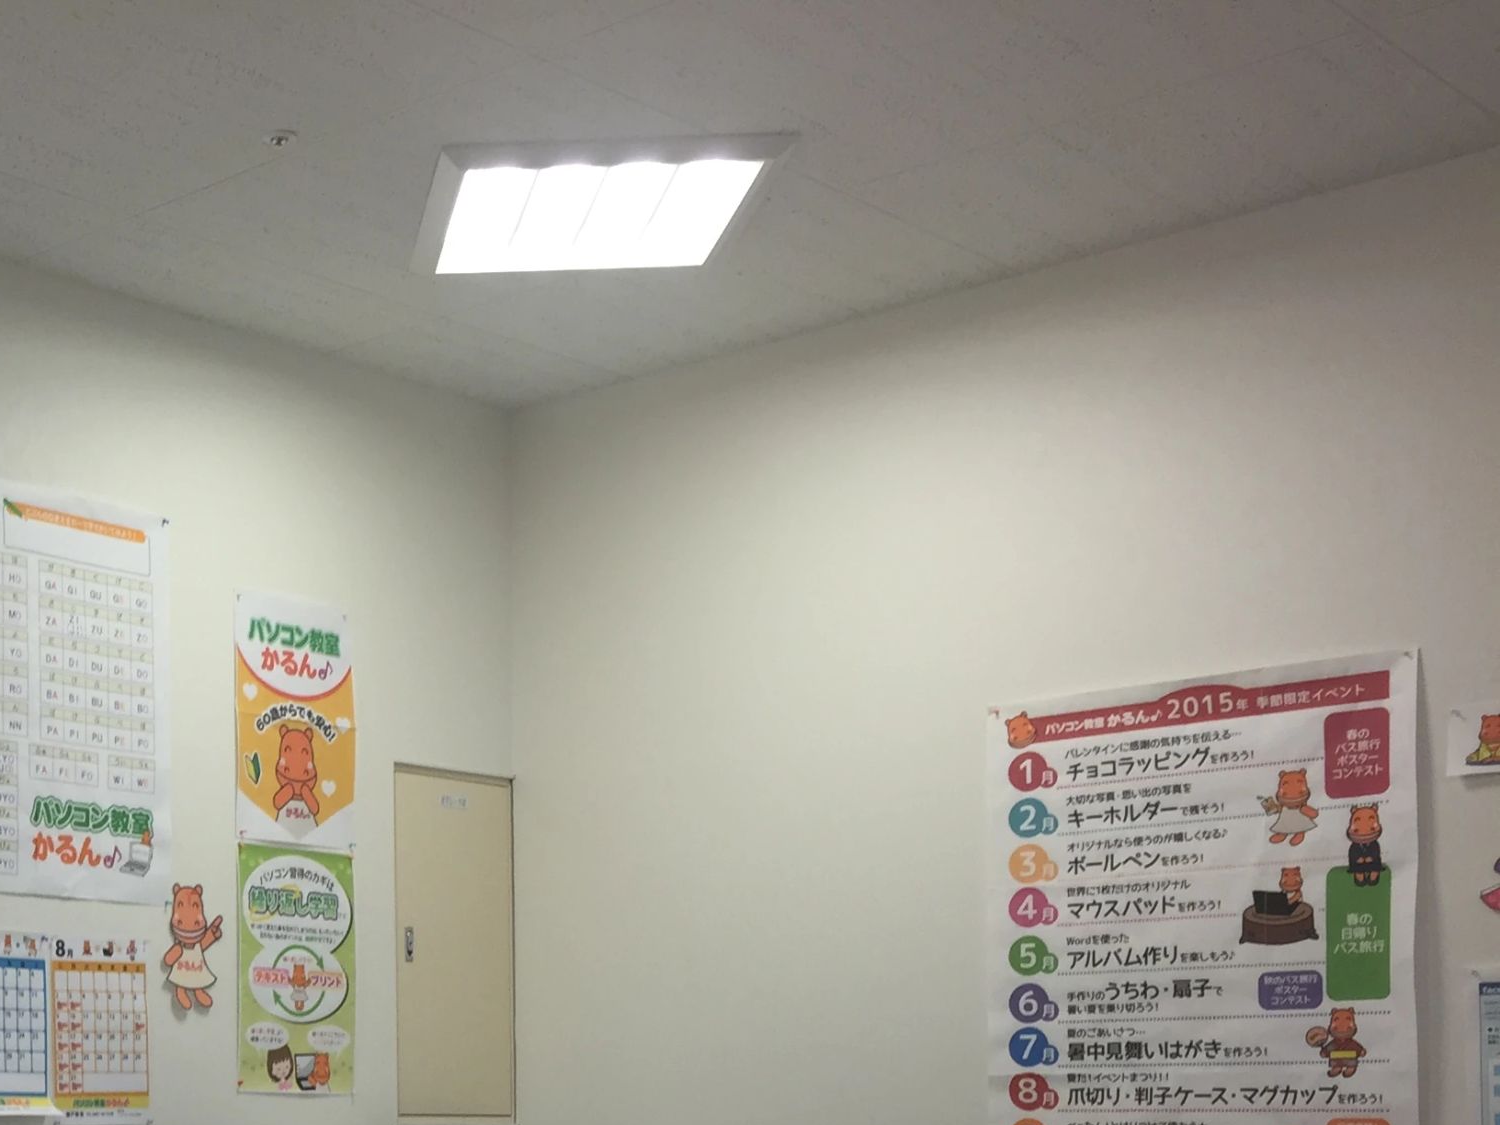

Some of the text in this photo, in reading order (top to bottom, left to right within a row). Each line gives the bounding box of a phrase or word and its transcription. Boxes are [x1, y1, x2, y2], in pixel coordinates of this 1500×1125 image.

[248, 617, 341, 658] パソコン教室
[261, 647, 316, 679] かるん
[1045, 717, 1105, 736] パソコン教室
[1166, 691, 1248, 720] 2015年
[1256, 684, 1365, 710] 季節限定イベント
[256, 704, 336, 743] 60歳からでも安心!
[1346, 728, 1370, 740] 春の
[1334, 739, 1381, 755] バス旅行
[1018, 758, 1054, 785] 1月
[1066, 746, 1255, 782] チョコラッピングを作ろう!
[1337, 753, 1379, 766] ポスター
[1332, 765, 1384, 780] コンテスト
[1066, 783, 1192, 806] 大切な写真・思い出の写真を
[31, 797, 152, 836] パソコン教室
[1018, 804, 1055, 831] 2月
[1067, 800, 1225, 828] キーホルダーで残そう!
[32, 832, 101, 867] かるん
[1019, 850, 1055, 877] 3月
[1067, 851, 1204, 875] ボールペンを作ろう!
[1067, 879, 1191, 898] 世界に1枚だけのオリジナル
[249, 887, 338, 921] 繰り返し学習
[1016, 894, 1055, 921] 4月
[1067, 896, 1222, 919] マウスパッドを作ろう!
[1346, 912, 1373, 926] 春の
[1066, 933, 1130, 946] Wordを使った
[1341, 925, 1378, 940] 日帰り
[55, 939, 73, 958] 8月
[1019, 943, 1055, 969] 5月
[1333, 939, 1385, 955] バス旅行
[254, 970, 288, 984] テキスト
[310, 975, 342, 988] プリント
[1067, 978, 1224, 1002] 手作りのうちわ・扇子で
[1017, 990, 1056, 1017] 6月
[1067, 1003, 1159, 1015] 暑い夏を乗り切ろう!
[1018, 1033, 1056, 1060] 7月
[1067, 1040, 1269, 1062] 暑中見舞いはがきを作ろう!
[1017, 1077, 1055, 1105] 8月
[1067, 1084, 1383, 1106] 爪切り・判子ケース・マグカップを作ろう!
